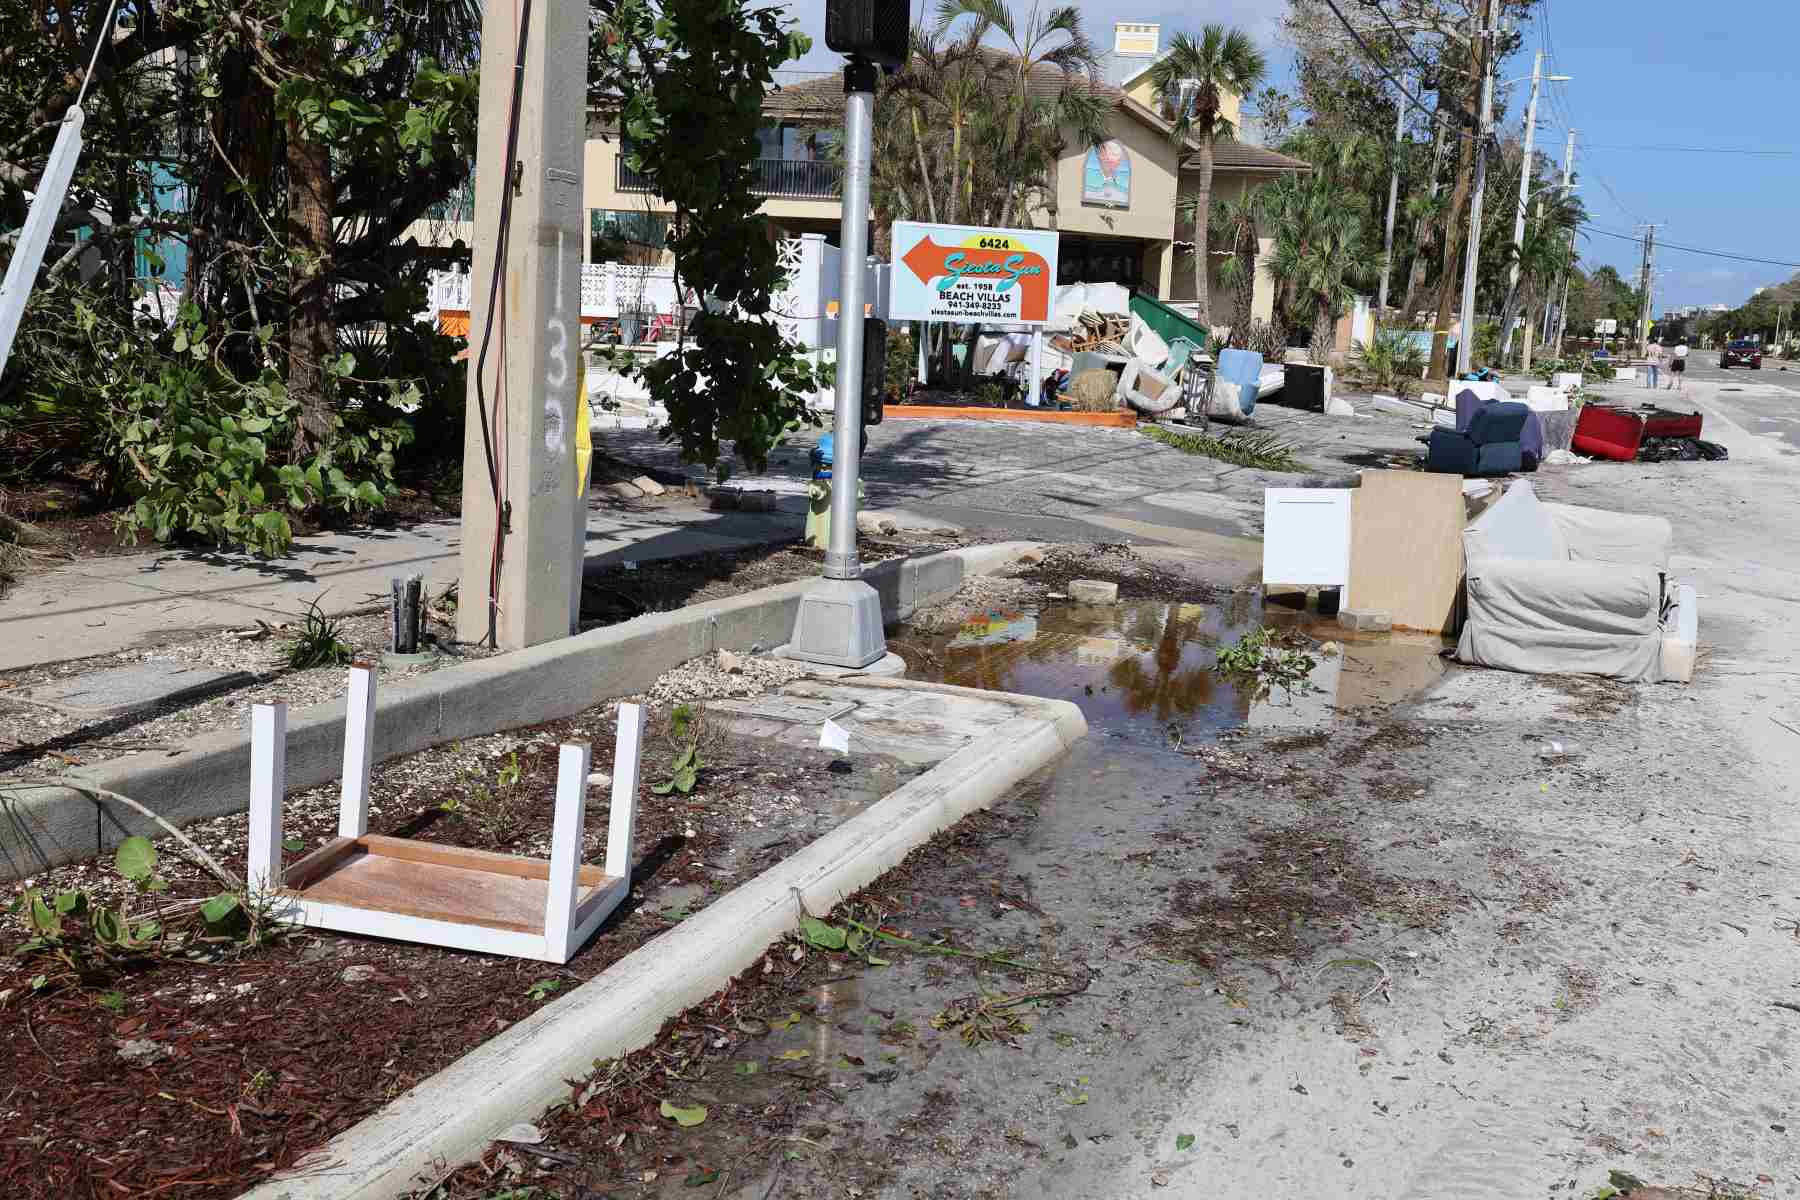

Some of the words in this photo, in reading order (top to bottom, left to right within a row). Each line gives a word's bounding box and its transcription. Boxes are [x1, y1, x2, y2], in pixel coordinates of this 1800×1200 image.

[979, 237, 1009, 249] 6424
[936, 252, 1001, 291] Siesta
[995, 254, 1041, 292] Sun
[973, 283, 993, 291] 1958
[940, 290, 974, 301] BEACH
[977, 292, 1011, 303] VILLAS
